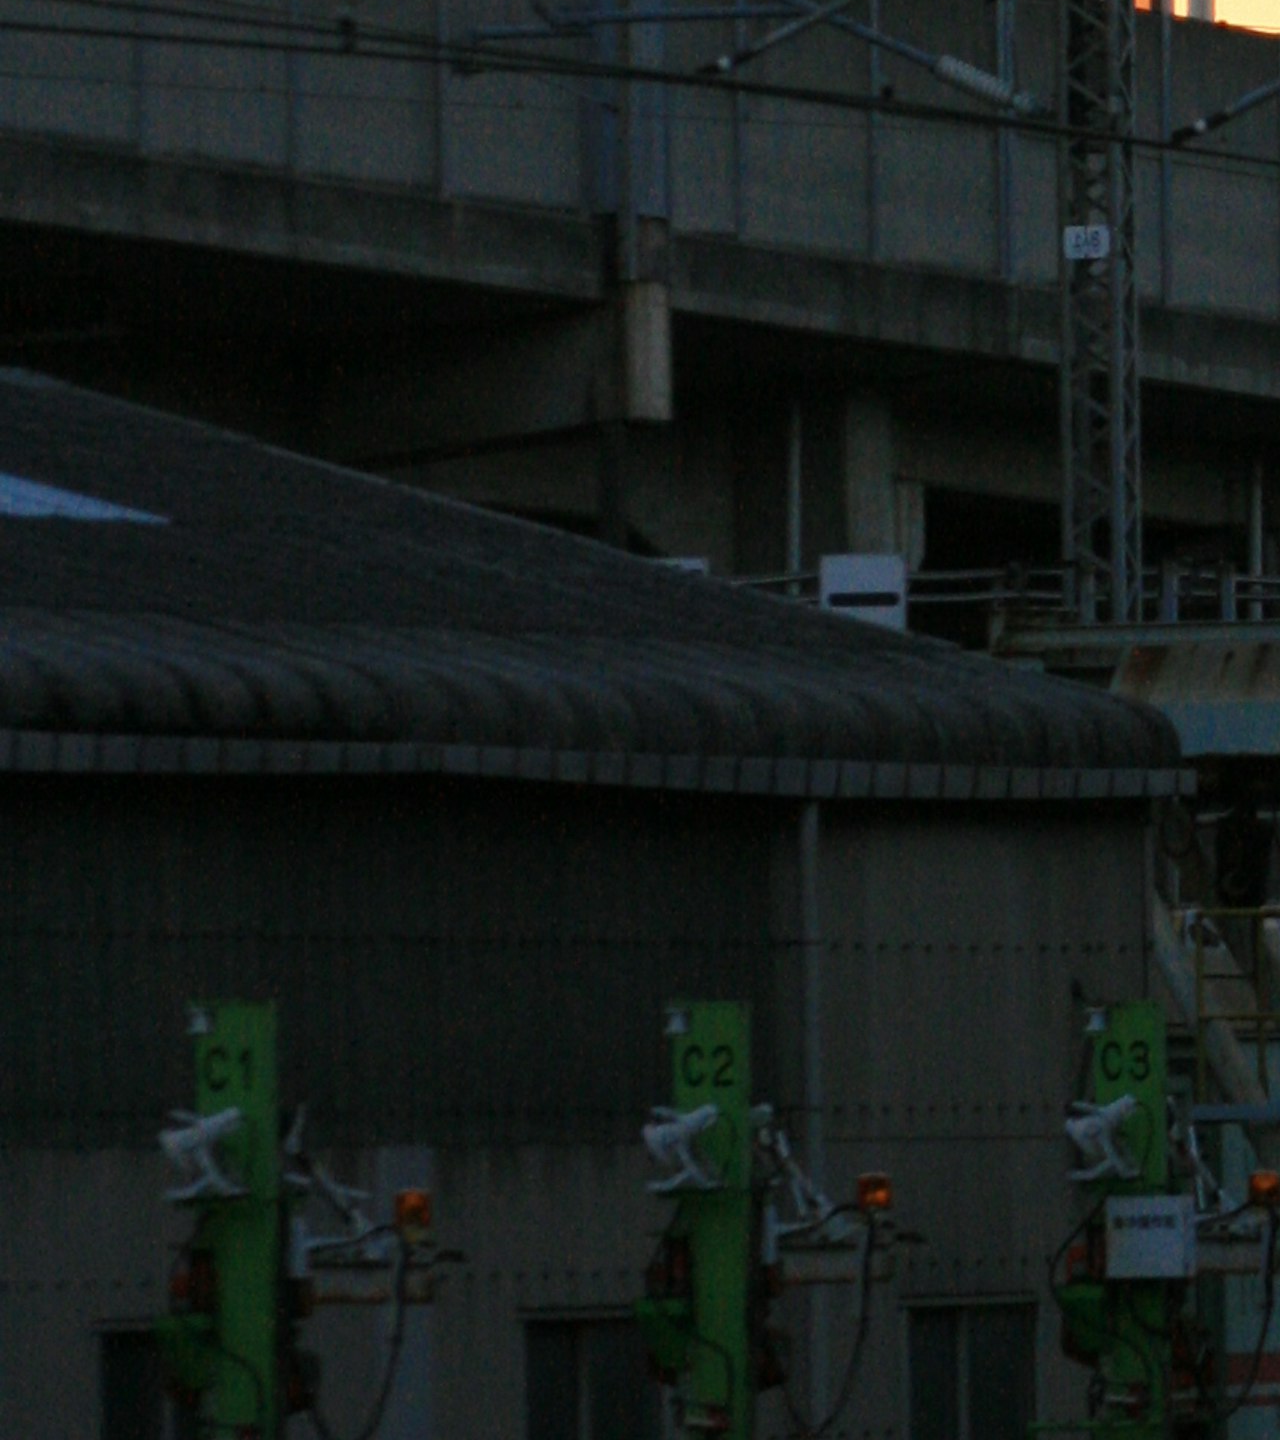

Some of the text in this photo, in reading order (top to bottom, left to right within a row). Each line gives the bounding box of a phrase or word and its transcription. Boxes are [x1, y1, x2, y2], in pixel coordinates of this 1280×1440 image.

[203, 1046, 252, 1093] C1
[682, 1045, 735, 1088] C2
[1101, 1040, 1150, 1082] C3
